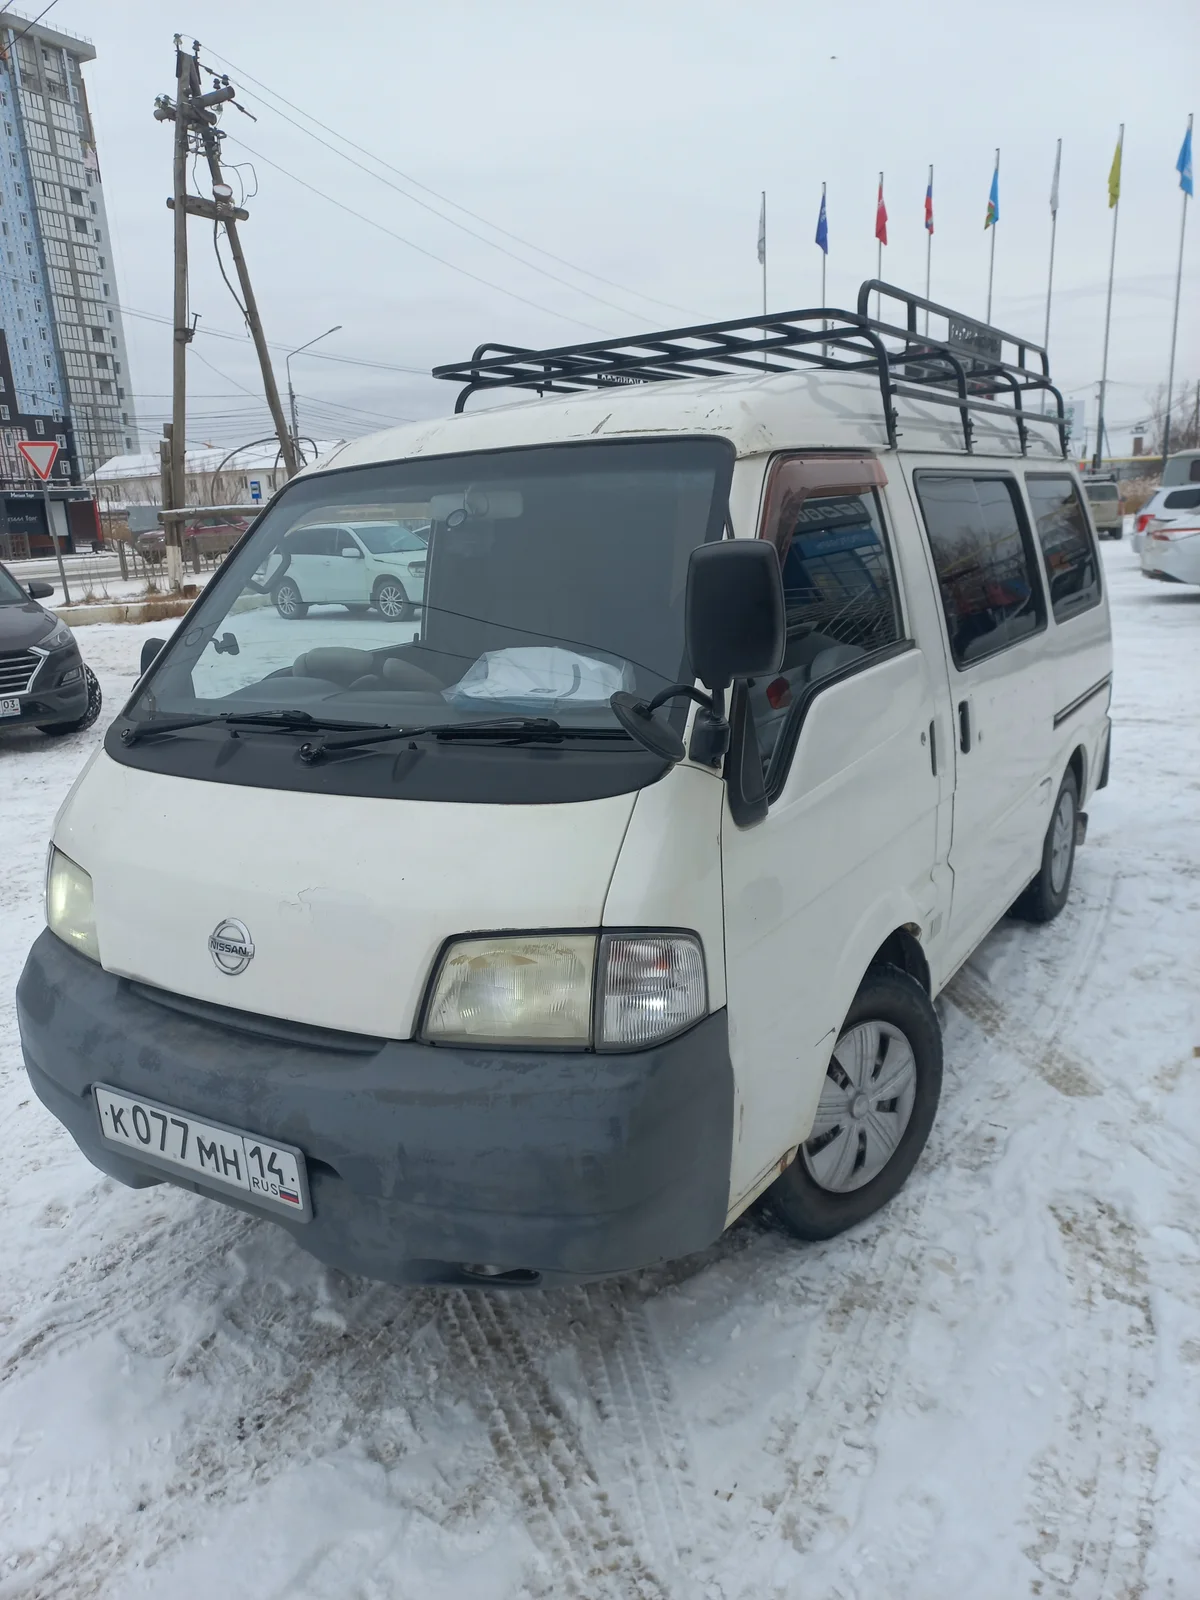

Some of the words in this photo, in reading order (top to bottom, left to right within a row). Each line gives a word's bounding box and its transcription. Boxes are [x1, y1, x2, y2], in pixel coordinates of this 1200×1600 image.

[3, 700, 15, 709] 03
[210, 940, 248, 956] NISSAN
[250, 1145, 285, 1186] 14
[252, 1176, 279, 1196] RUS
